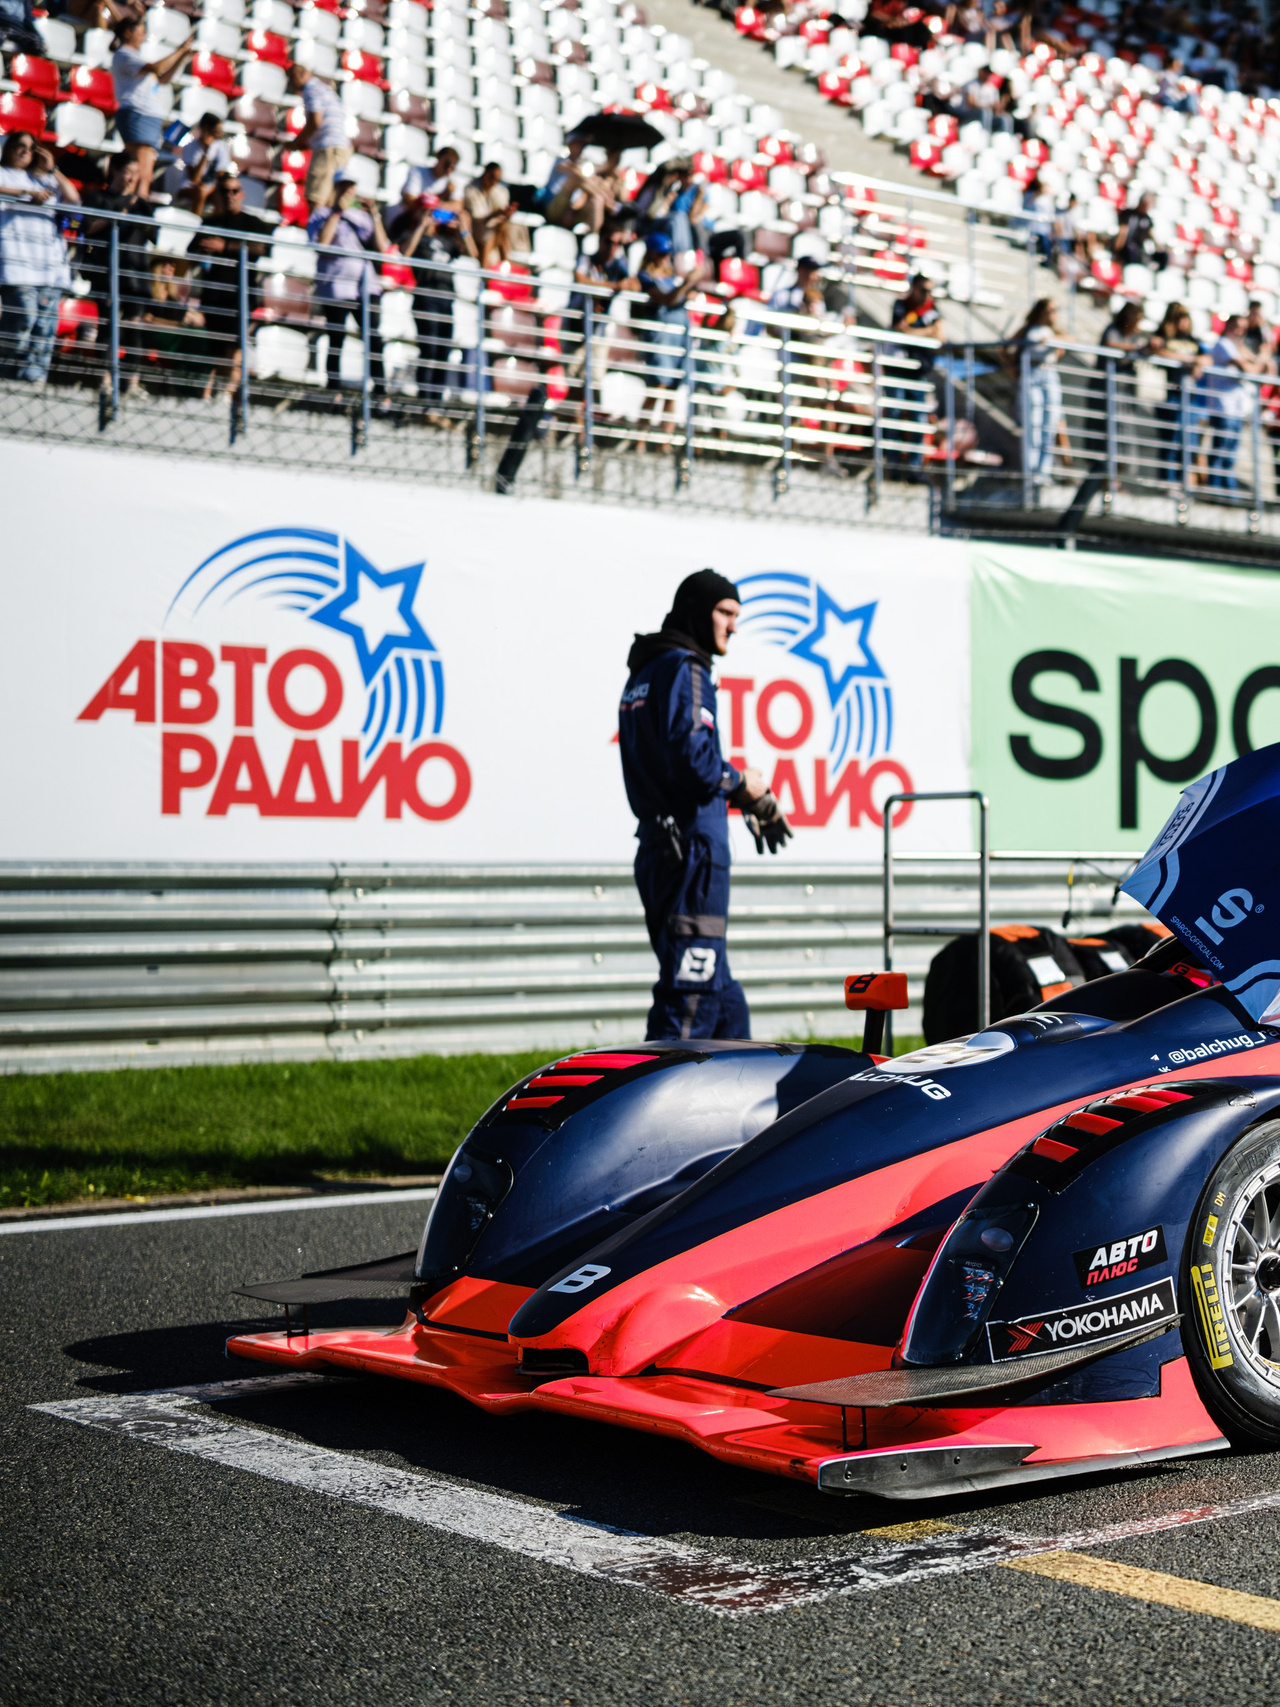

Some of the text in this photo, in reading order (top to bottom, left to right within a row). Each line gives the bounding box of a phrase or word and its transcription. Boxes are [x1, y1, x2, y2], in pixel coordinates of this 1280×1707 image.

[77, 638, 344, 731] АВТО
[161, 731, 472, 822] РАДИО
[849, 1072, 952, 1101] ALCHUG
[1087, 1257, 1139, 1287] ПЛЮС
[1089, 1229, 1159, 1271] АВТО
[547, 1263, 612, 1294] B
[1044, 1293, 1165, 1342] YOKOHAMA
[1190, 1262, 1235, 1370] PIRELLI
